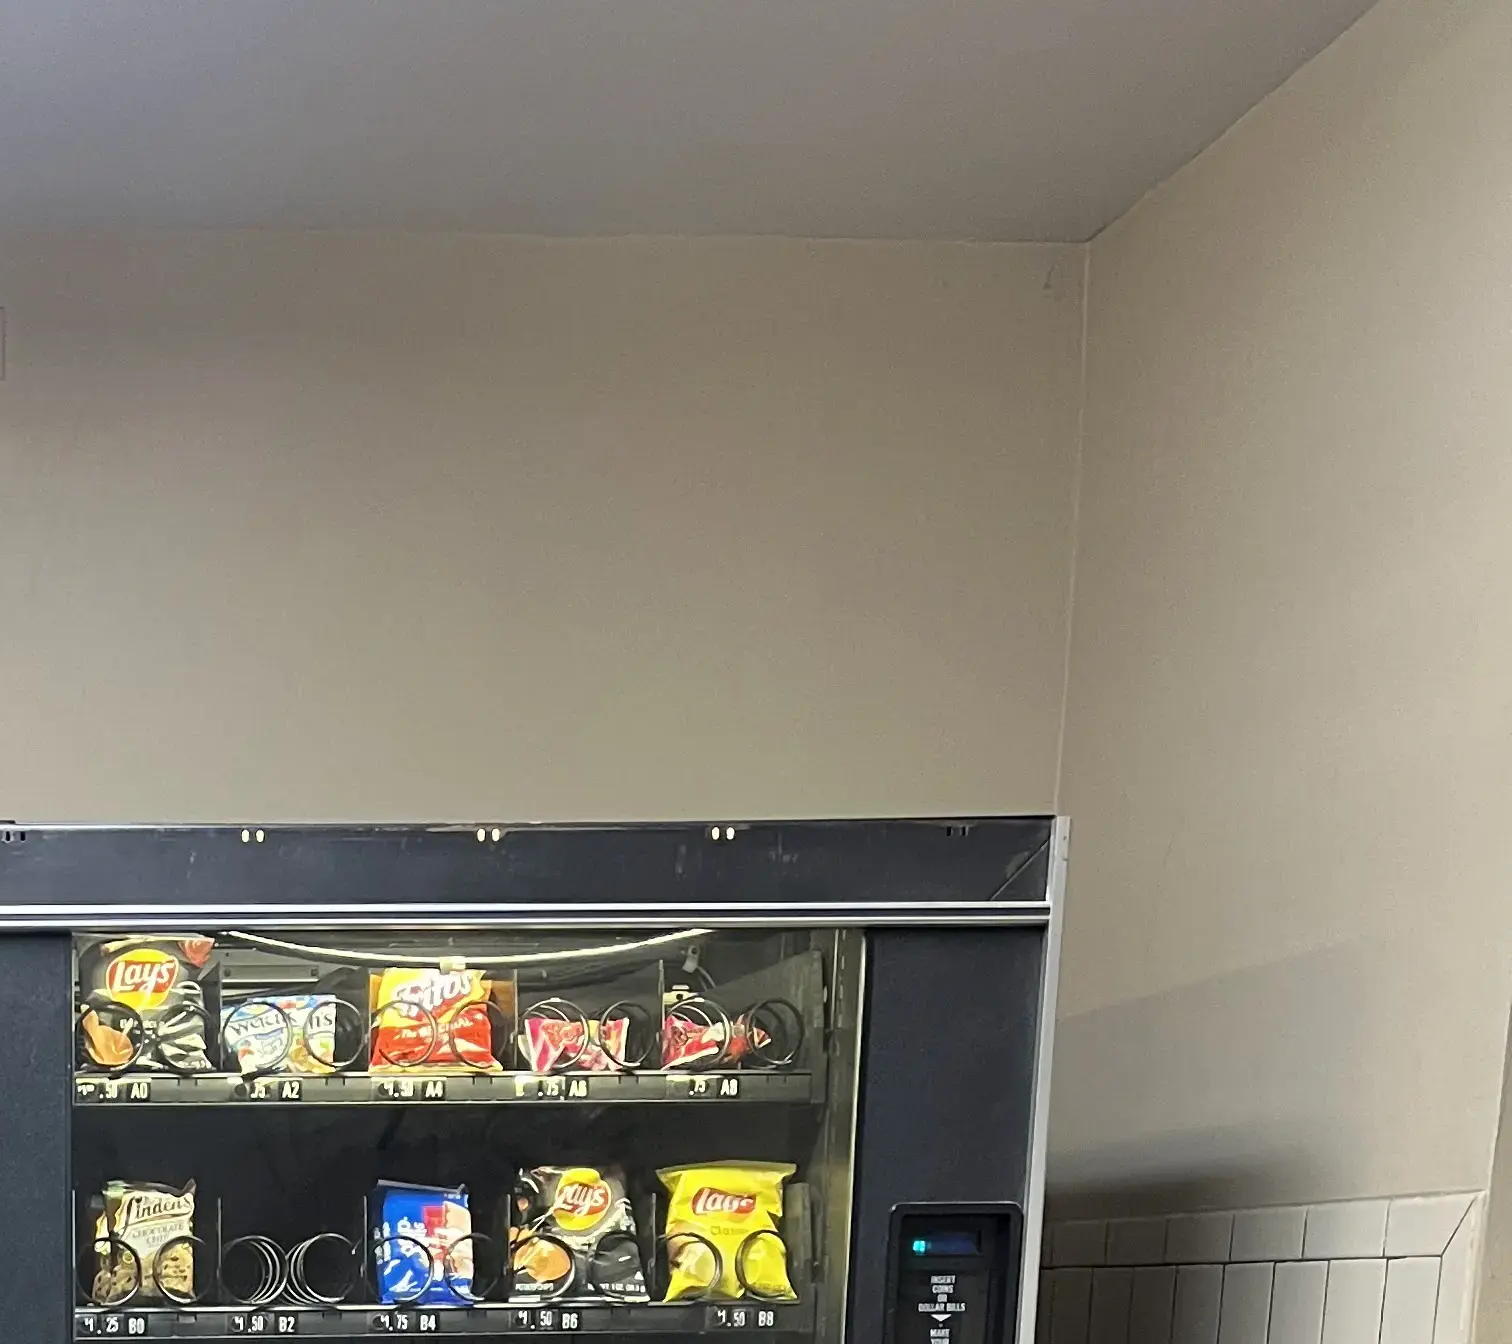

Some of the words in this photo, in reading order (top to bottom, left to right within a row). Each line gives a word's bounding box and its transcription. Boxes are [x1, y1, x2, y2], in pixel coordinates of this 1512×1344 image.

[282, 1081, 300, 1099] A2
[425, 1081, 444, 1098] A4
[128, 1317, 146, 1334] B0
[279, 1316, 295, 1332] B2
[420, 1314, 436, 1330] B4
[562, 1314, 578, 1329] B6
[758, 1310, 774, 1327] B8
